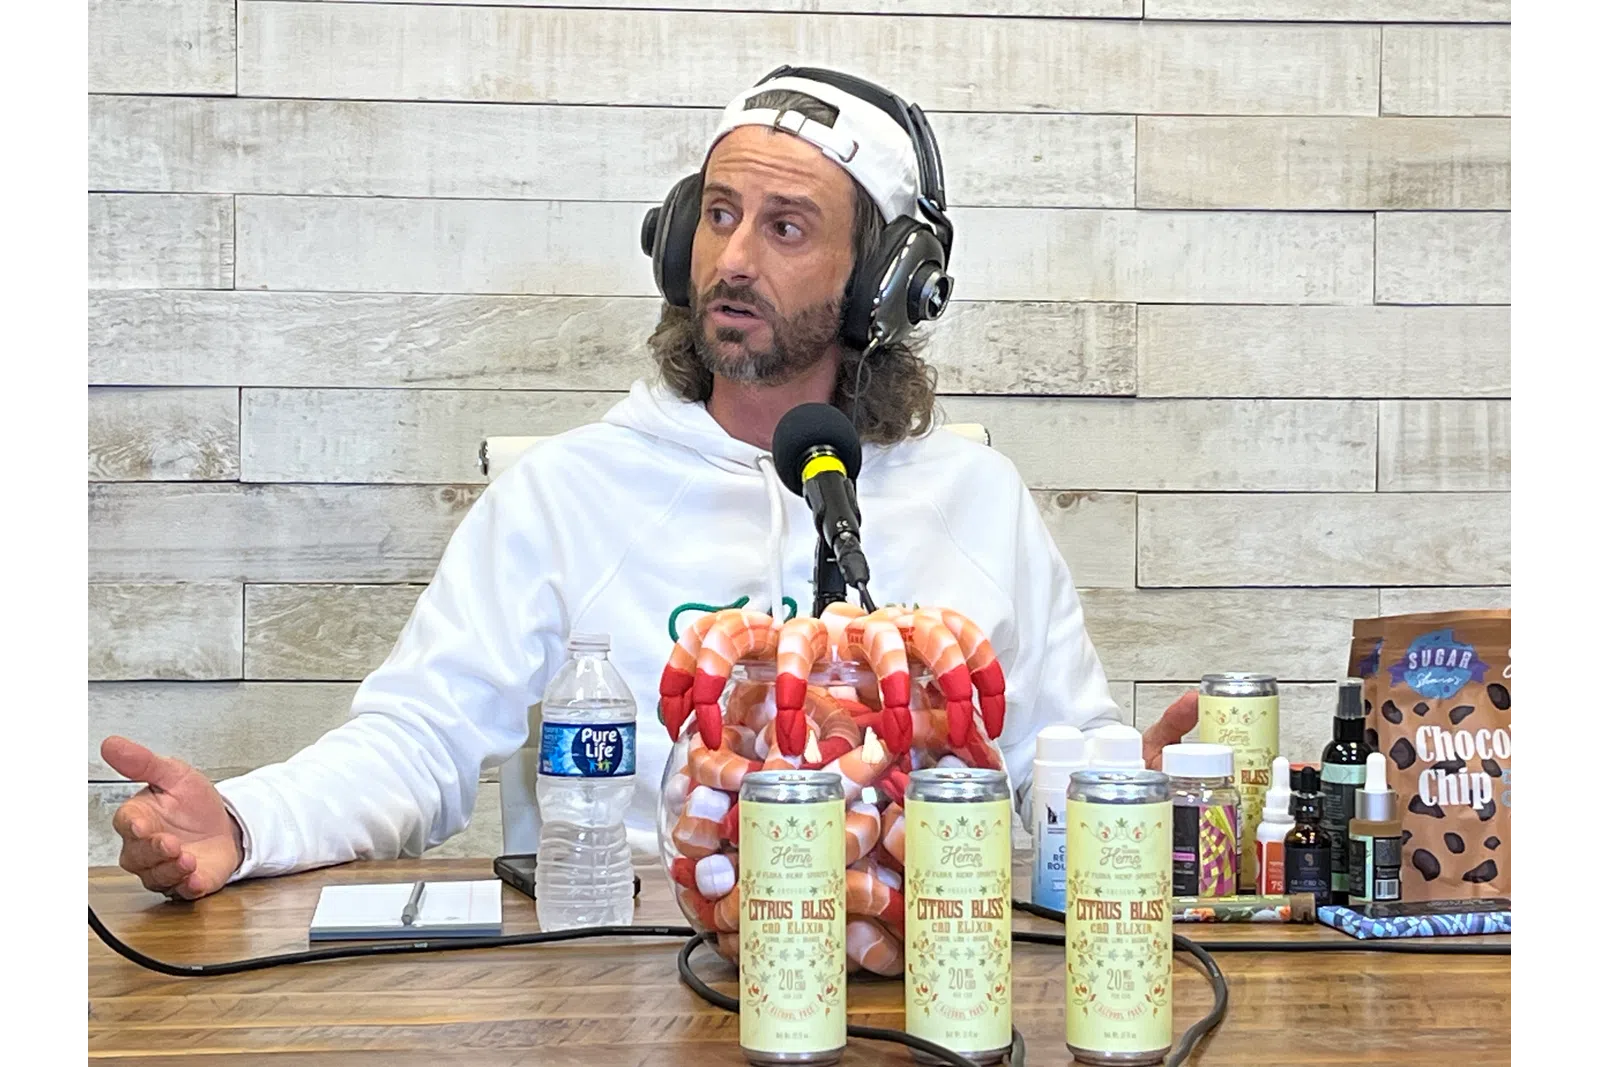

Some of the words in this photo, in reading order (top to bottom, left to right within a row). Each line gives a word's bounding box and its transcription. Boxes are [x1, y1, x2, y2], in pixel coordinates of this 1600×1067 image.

[1408, 648, 1472, 670] SUGAR
[581, 727, 617, 743] Pure
[1415, 725, 1511, 762] Choco
[585, 743, 614, 761] Life
[1241, 769, 1269, 786] BLISS
[1418, 767, 1492, 809] Chip
[770, 845, 812, 869] Hemp
[940, 845, 983, 868] Hemp
[1100, 846, 1142, 870] Hemp
[749, 898, 793, 921] CITRUS
[801, 898, 835, 920] BLISS
[917, 897, 963, 920] CITRUS
[971, 897, 1004, 920] BLISS
[1077, 898, 1122, 921] CITRUS
[1130, 899, 1163, 921] BLISS
[762, 923, 780, 934] CBD
[788, 922, 824, 934] ELIXIR
[932, 922, 950, 933] CBD
[957, 921, 993, 933] ELIXIR
[1090, 923, 1109, 934] CBD
[1116, 922, 1152, 935] ELIXIR
[778, 968, 793, 991] 20
[948, 967, 963, 990] 20
[1106, 968, 1121, 991] 20
